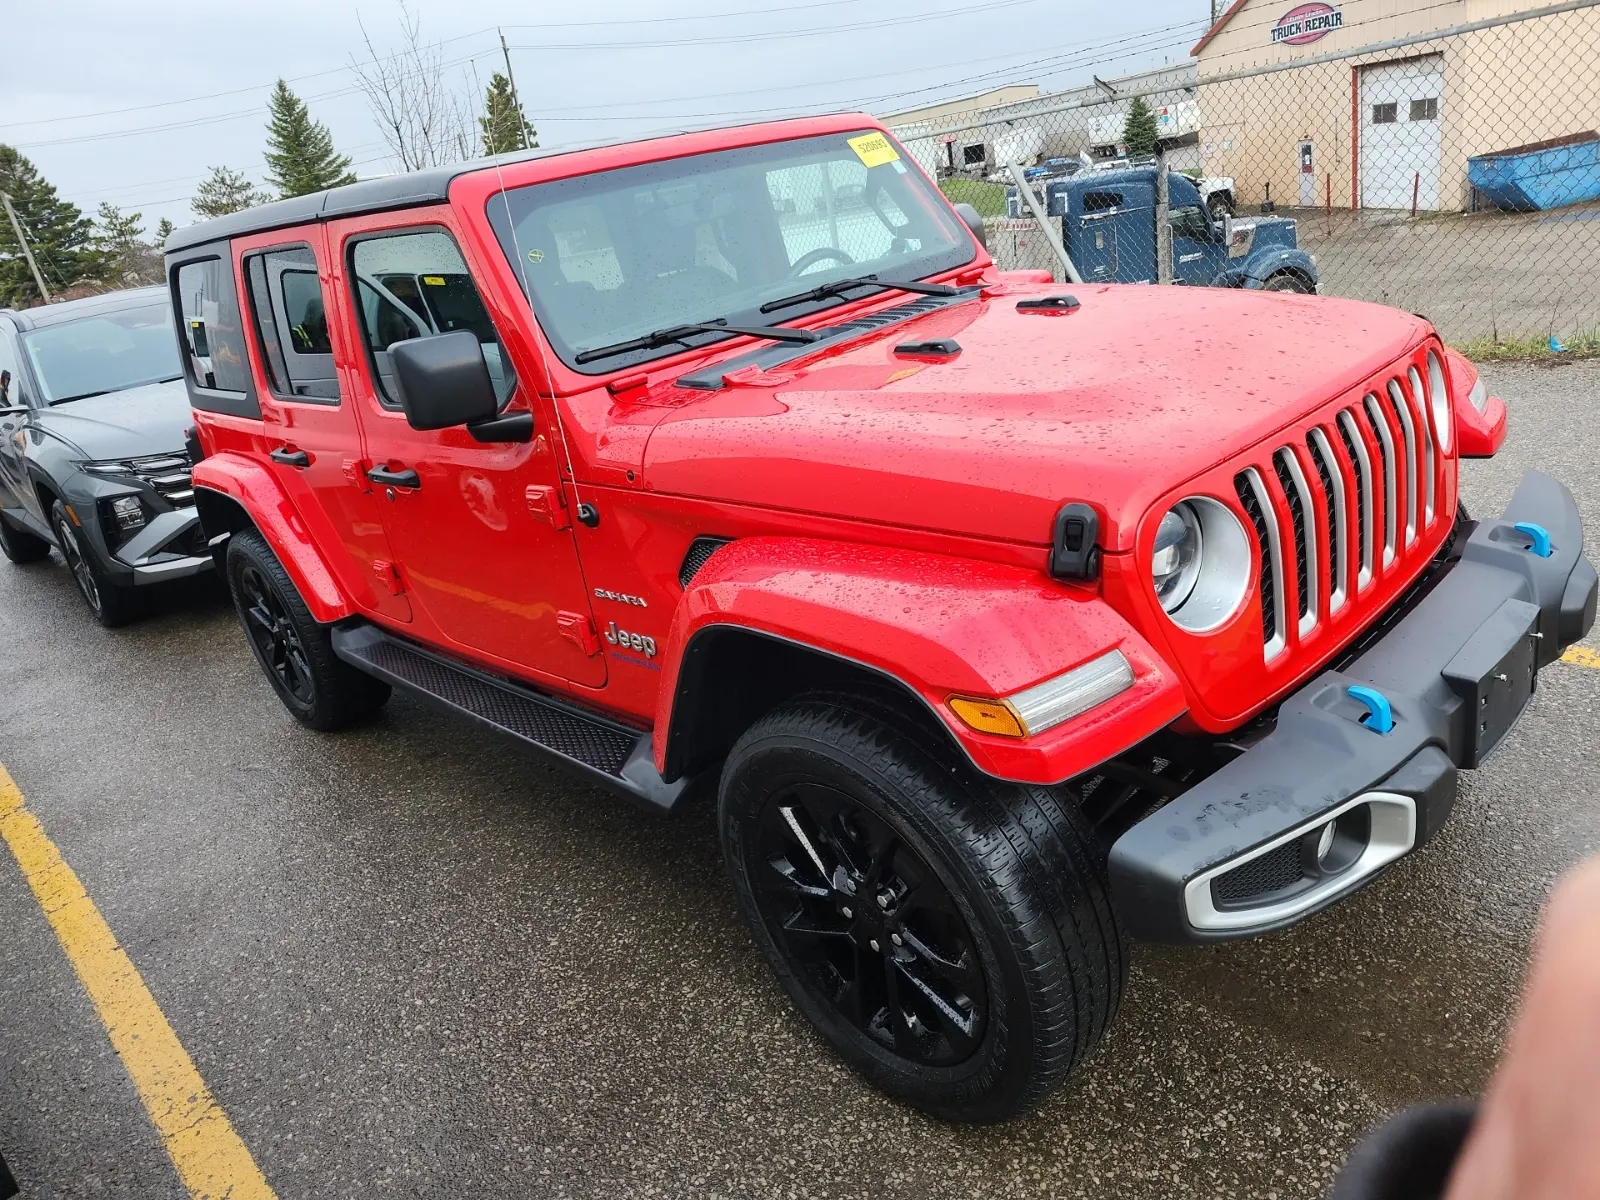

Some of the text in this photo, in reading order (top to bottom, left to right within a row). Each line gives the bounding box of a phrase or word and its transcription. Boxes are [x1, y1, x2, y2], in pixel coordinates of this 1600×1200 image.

[1270, 22, 1302, 41] TRUCK
[1304, 11, 1343, 31] REPAIR
[604, 621, 658, 659] Jeep
